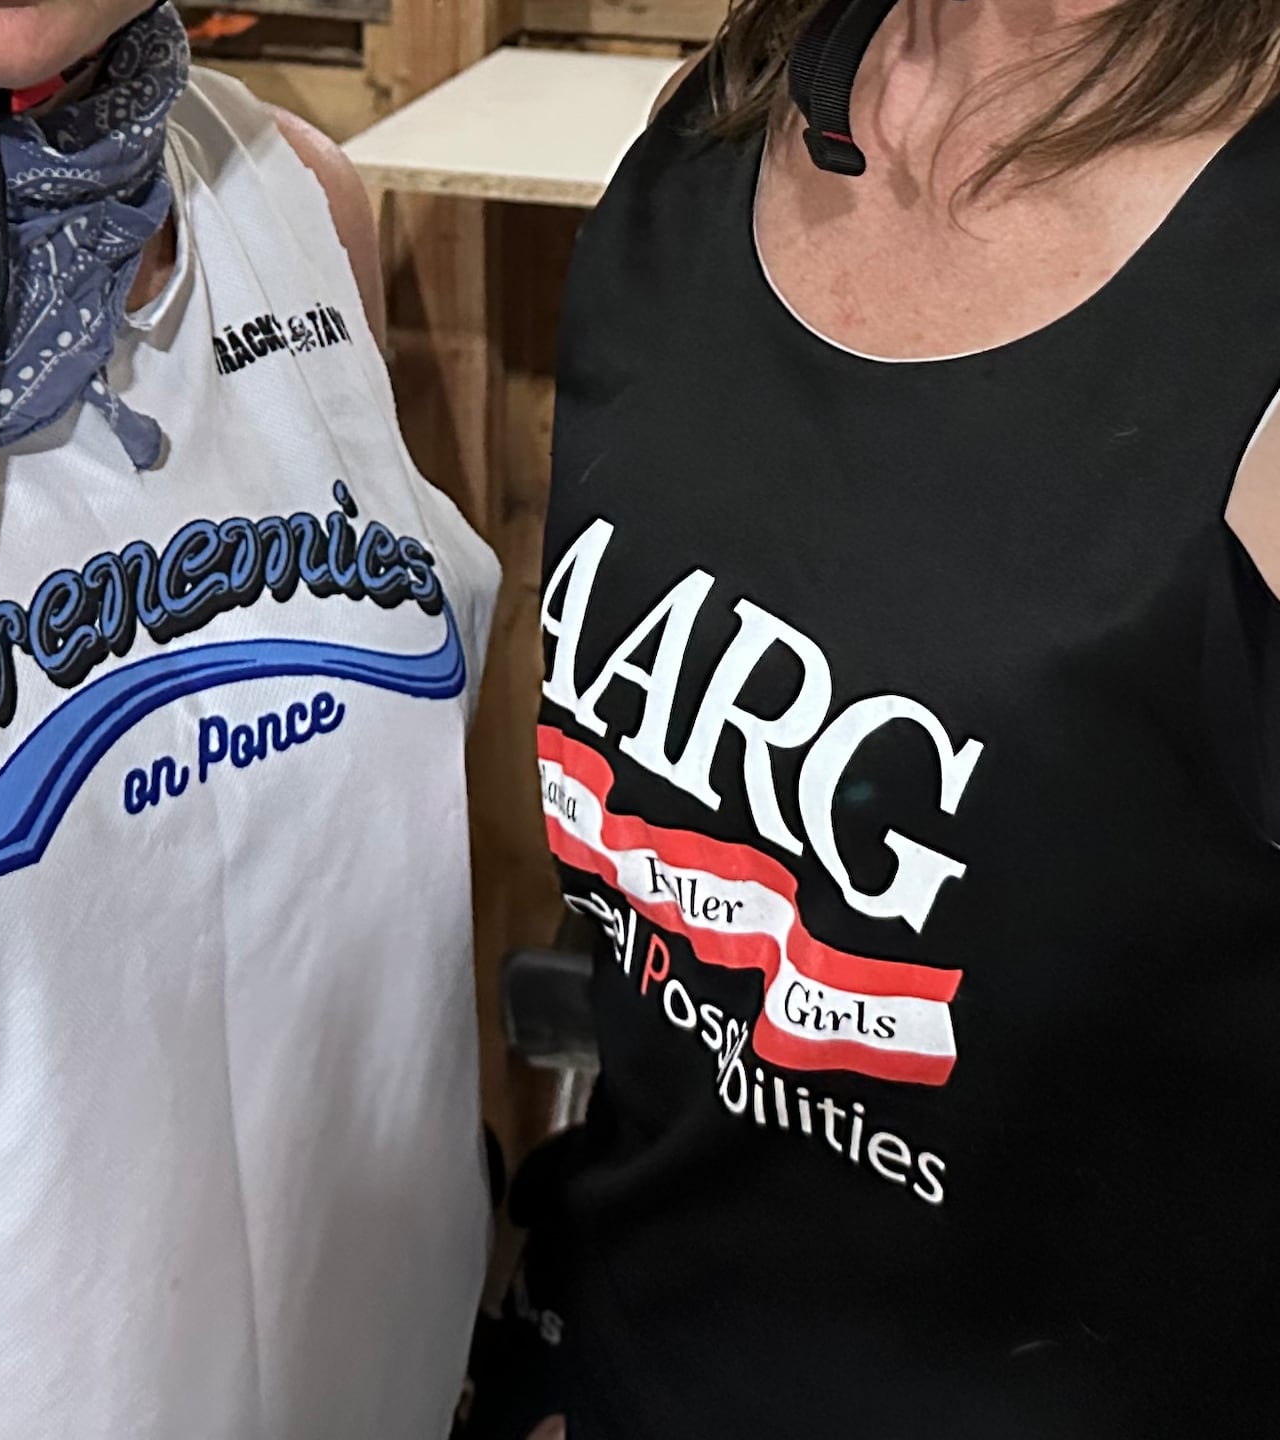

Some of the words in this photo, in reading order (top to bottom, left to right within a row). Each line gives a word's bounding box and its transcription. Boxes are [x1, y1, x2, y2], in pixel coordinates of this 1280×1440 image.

[122, 755, 190, 815] on
[197, 690, 346, 785] Ponce
[540, 517, 985, 934] AARG
[783, 981, 898, 1040] Girls
